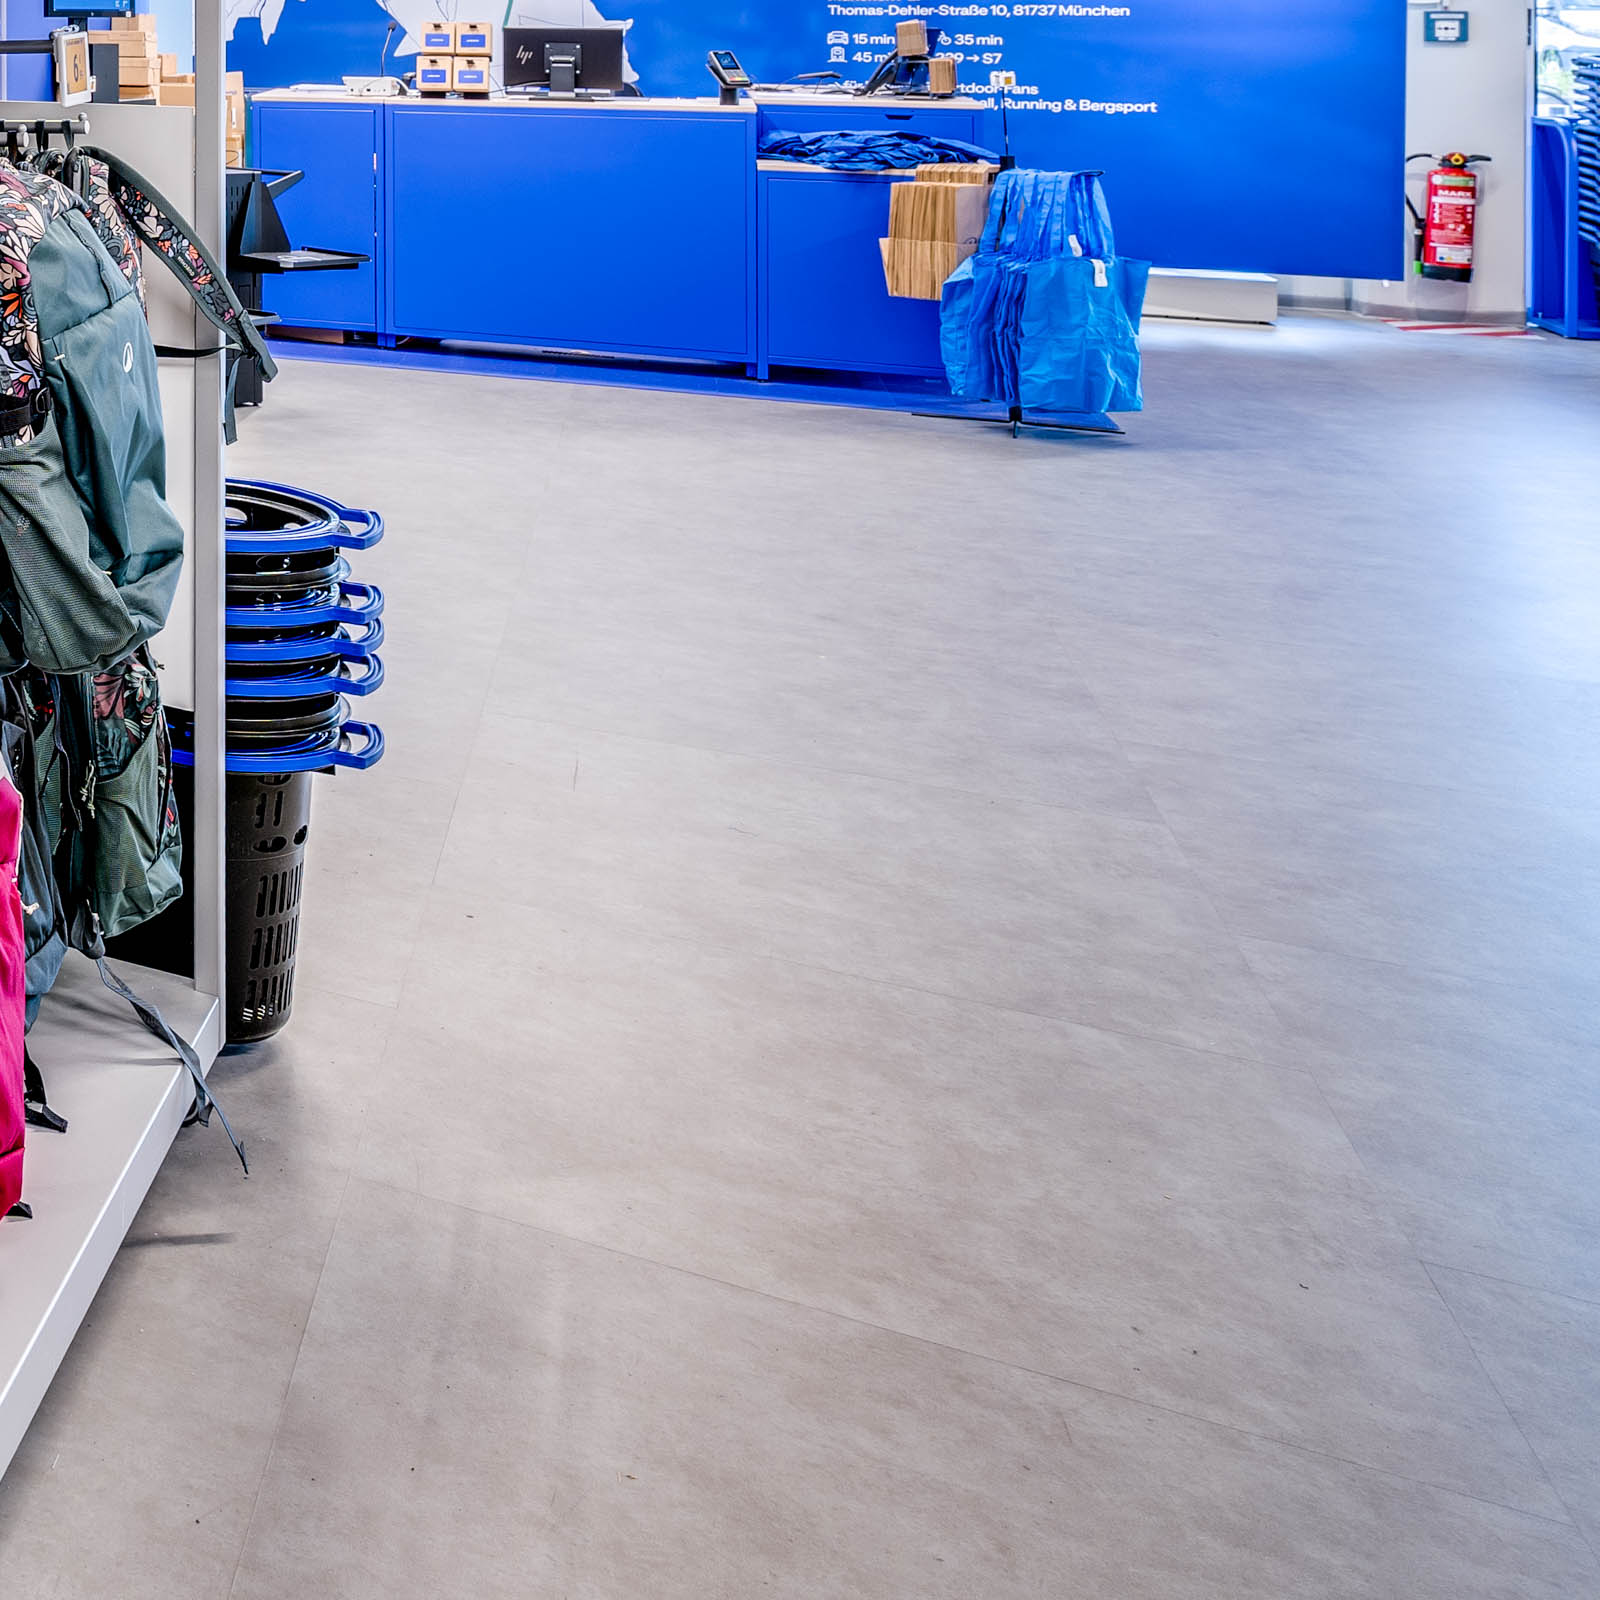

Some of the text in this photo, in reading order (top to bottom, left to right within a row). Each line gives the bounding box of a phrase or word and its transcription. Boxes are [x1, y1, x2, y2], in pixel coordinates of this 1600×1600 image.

[827, 4, 1131, 18] Thomas-Dehler-Straße 10, 81737 München
[852, 33, 896, 45] 15 min
[954, 33, 1003, 45] 35 min
[852, 51, 873, 63] 45
[982, 52, 1003, 64] S7
[1064, 99, 1077, 111] &
[1078, 99, 1158, 114] Bergsport
